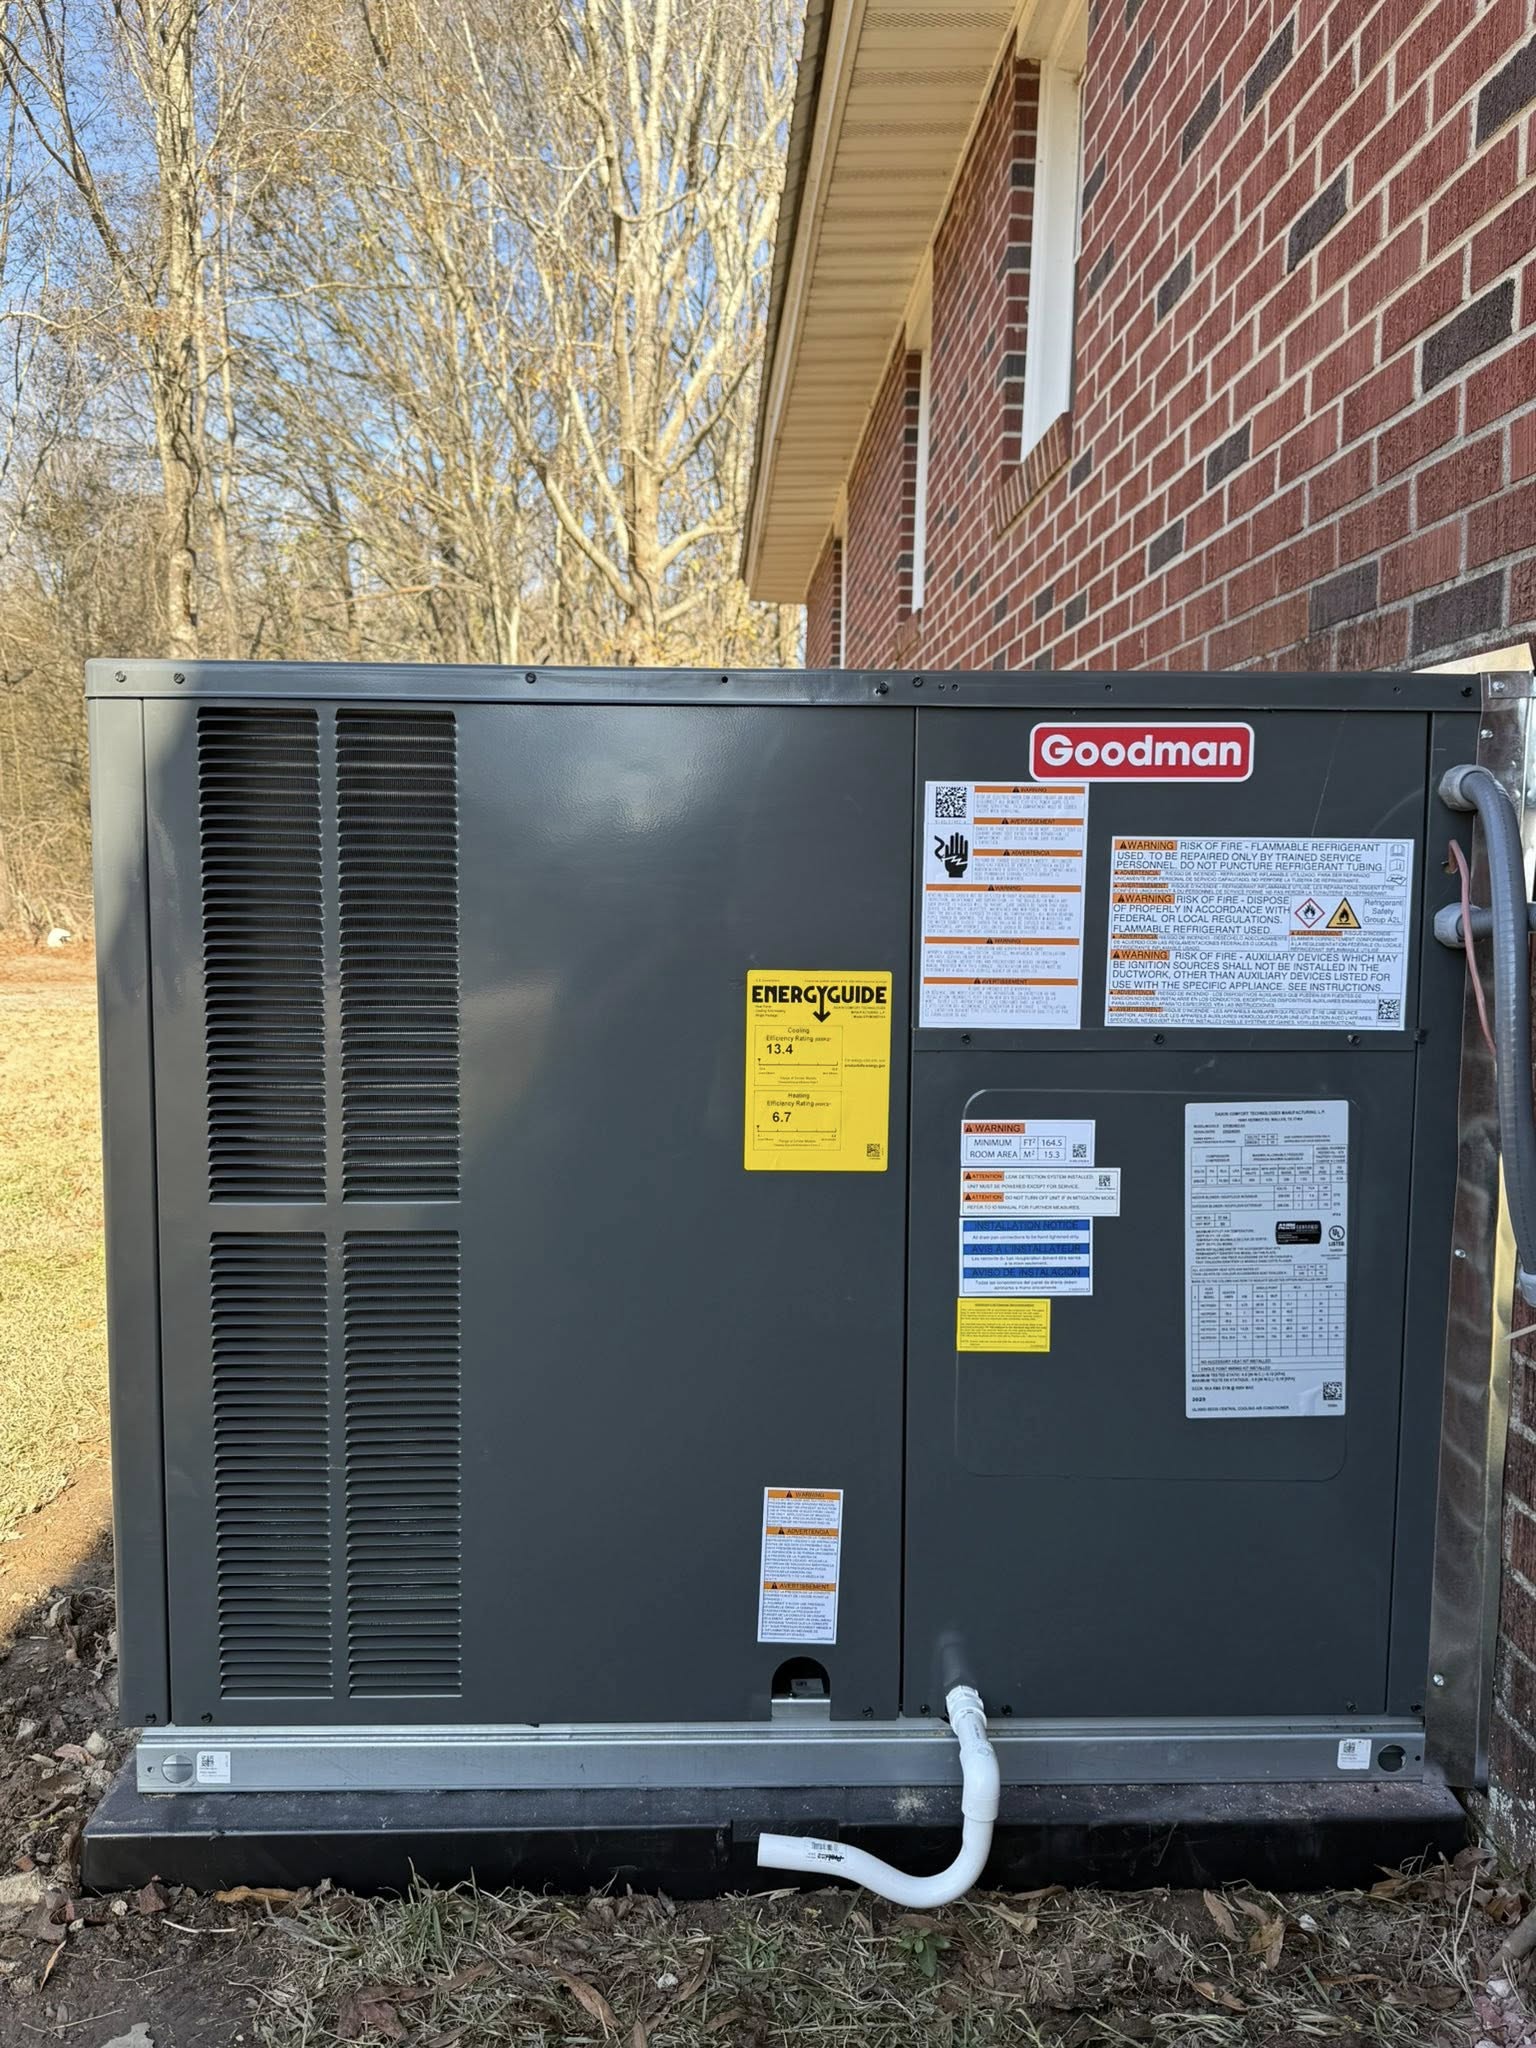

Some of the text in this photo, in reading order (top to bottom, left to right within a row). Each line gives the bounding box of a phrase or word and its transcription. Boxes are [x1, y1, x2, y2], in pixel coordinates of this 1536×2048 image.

[1041, 734, 1242, 767] Goodman
[1128, 841, 1174, 850] WARNING
[1180, 842, 1202, 850] RISK
[1205, 842, 1218, 850] OF
[1221, 842, 1241, 851] FIRE
[1251, 842, 1309, 851] FLAMMABLE
[1312, 843, 1380, 852] REFRIGERANT
[1150, 852, 1162, 860] TO
[1165, 852, 1178, 860] BE
[1180, 852, 1229, 861] REPAIRED
[1231, 853, 1258, 861] ONLY
[1276, 853, 1317, 861] TRAINED
[1320, 854, 1362, 862] SERVICE
[1180, 861, 1194, 870] DO
[1197, 861, 1217, 870] NOT
[1220, 862, 1272, 871] PUNCTURE
[1275, 862, 1344, 871] REFRIGERANT
[1125, 895, 1172, 903] WARNING
[1176, 895, 1198, 904] RISK
[1201, 896, 1214, 904] OF
[1217, 896, 1238, 904] FIRE
[1247, 896, 1290, 905] DISPOSE
[1113, 904, 1290, 914] OF PROPERLY IN ACCORDANCE WITH
[1372, 907, 1394, 916] Safety
[1113, 914, 1156, 922] FEDERAL
[1161, 914, 1176, 923] OR
[1180, 914, 1209, 923] LOCAL
[1364, 916, 1385, 924] Group
[1113, 925, 1170, 933] FLAMMABLE
[1173, 925, 1240, 933] REFRIGERANT
[1122, 951, 1167, 959] WARNING
[1175, 952, 1197, 960] RISK
[1199, 952, 1213, 960] OF
[1216, 952, 1237, 960] FIRE
[1246, 953, 1295, 961] AUXILIARY
[1297, 953, 1339, 961] DEVICES
[1342, 954, 1375, 962] WHICH
[1377, 954, 1398, 962] MAY
[1113, 961, 1379, 972] BE IGNITION SOURCES SHALL NOT BE INSTALLED IN THE
[1113, 970, 1391, 981] DUCTWORK, OTHER THAN AUXILIARY DEVICES LISTED FOR
[1112, 980, 1131, 989] USE
[1134, 981, 1159, 989] WITH
[1161, 981, 1180, 989] THE
[1182, 981, 1226, 990] SPECIFIC
[1288, 982, 1307, 991] SEE
[1310, 983, 1383, 992] INSTRUCTIONS.
[752, 985, 887, 1006] ENERGYGUIDE
[787, 1027, 810, 1035] Cooling
[766, 1035, 794, 1043] Efficiency
[766, 1044, 793, 1054] 13.4
[788, 1092, 810, 1100] Heating
[772, 1111, 791, 1123] 6.7
[975, 1124, 1021, 1133] WARNING
[972, 1268, 1000, 1277] AVISO
